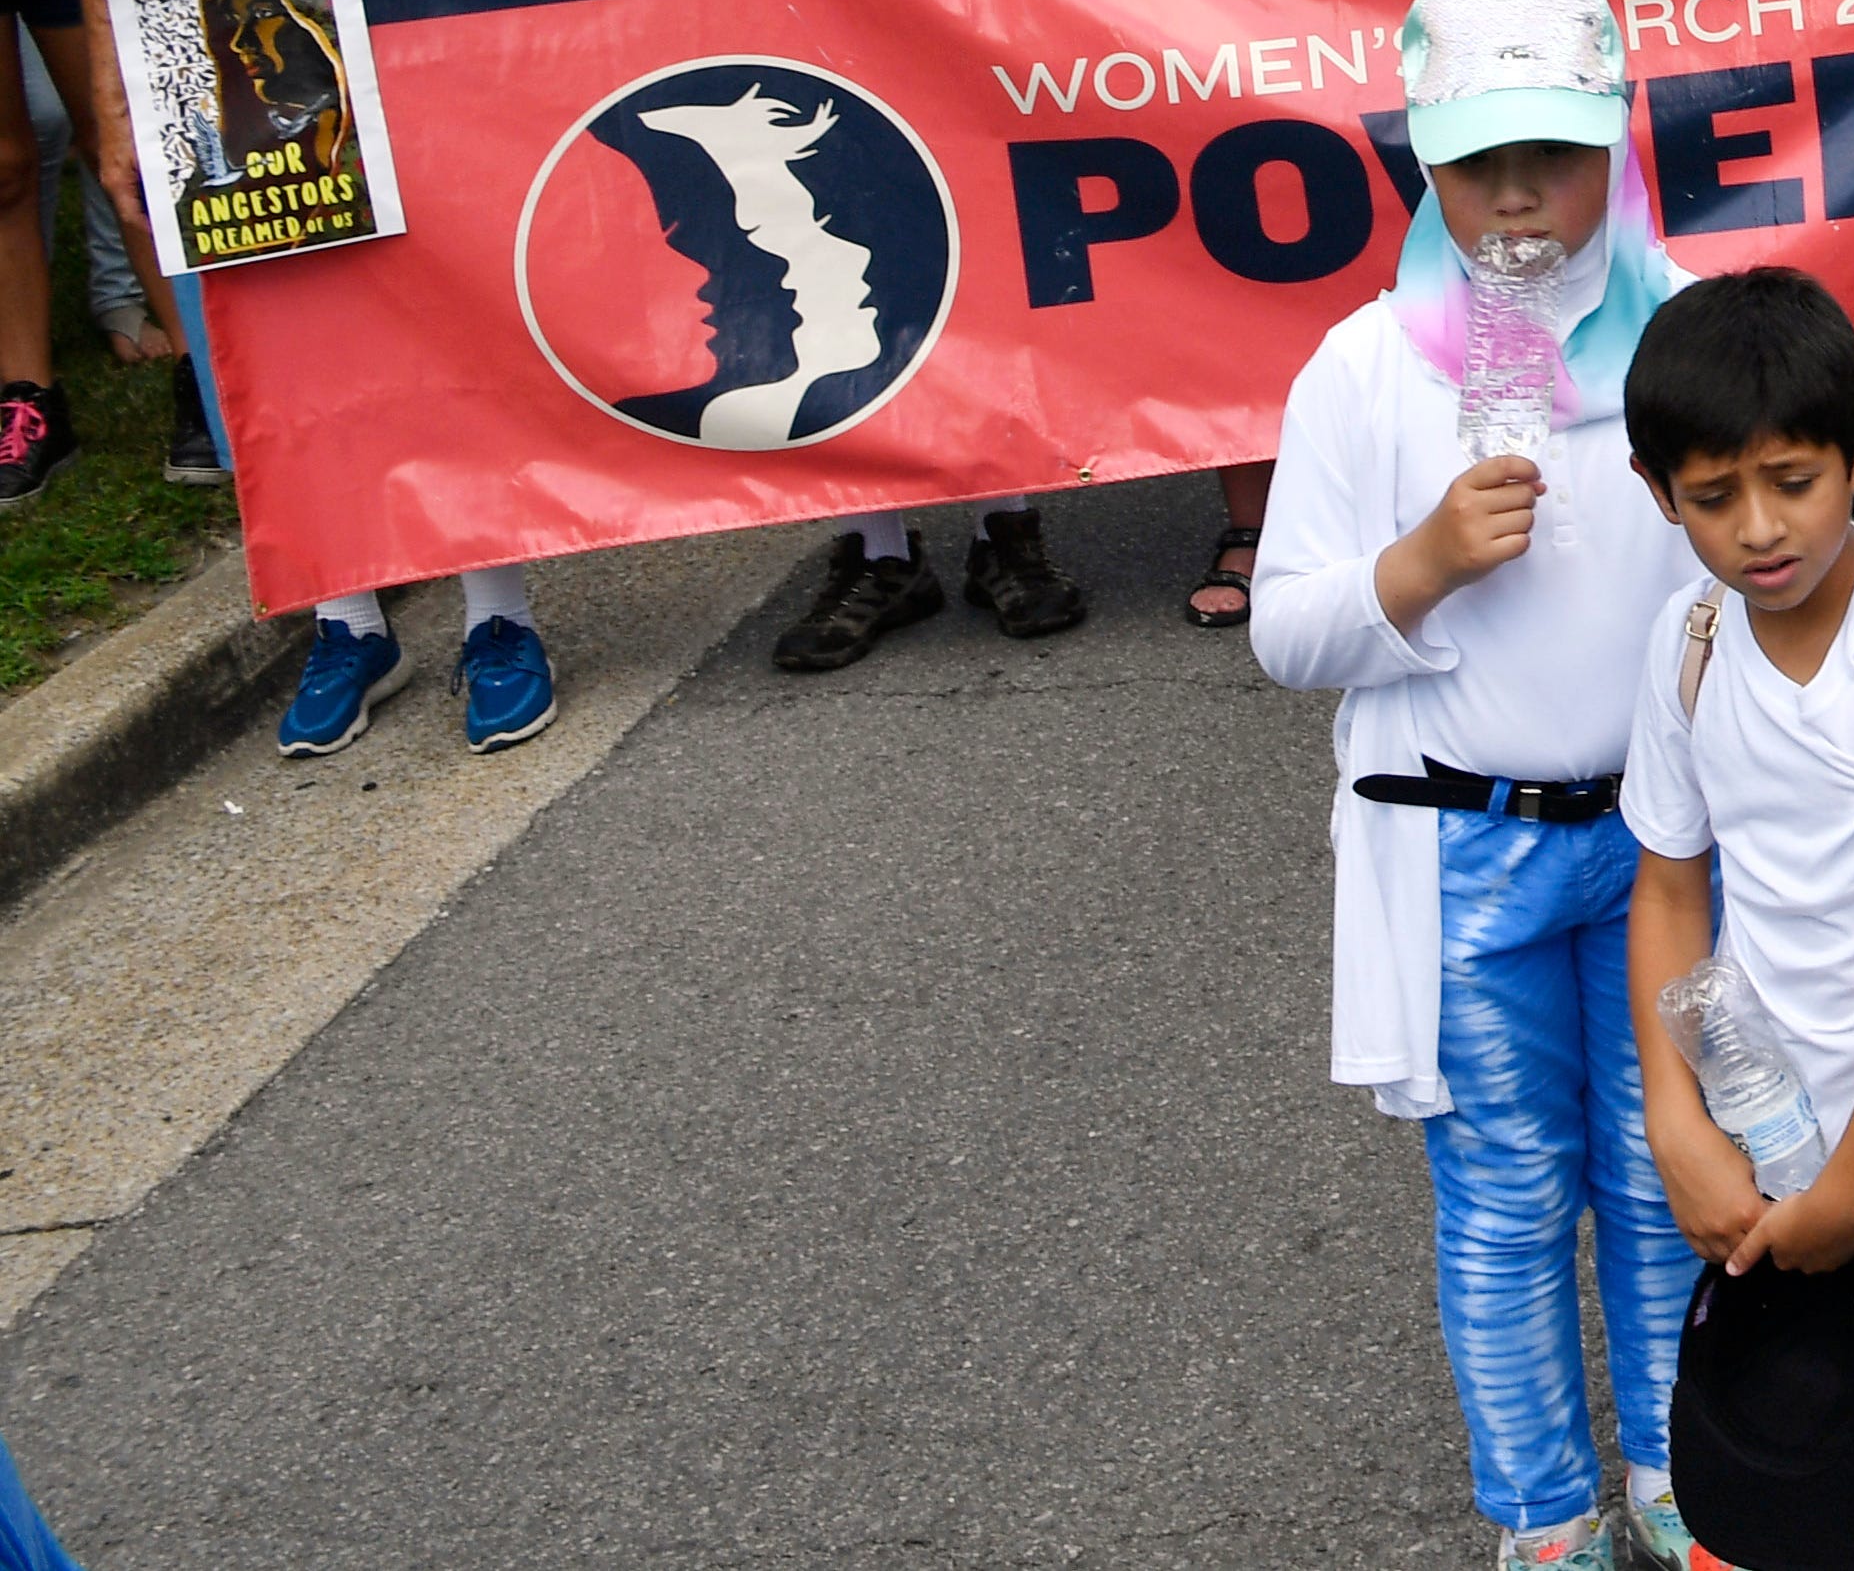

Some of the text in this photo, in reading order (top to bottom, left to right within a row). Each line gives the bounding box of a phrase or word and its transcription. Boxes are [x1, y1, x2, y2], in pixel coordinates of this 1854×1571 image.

[245, 141, 307, 179] OUR
[192, 173, 354, 228] ANCESTORS
[196, 216, 301, 256] DREAMED
